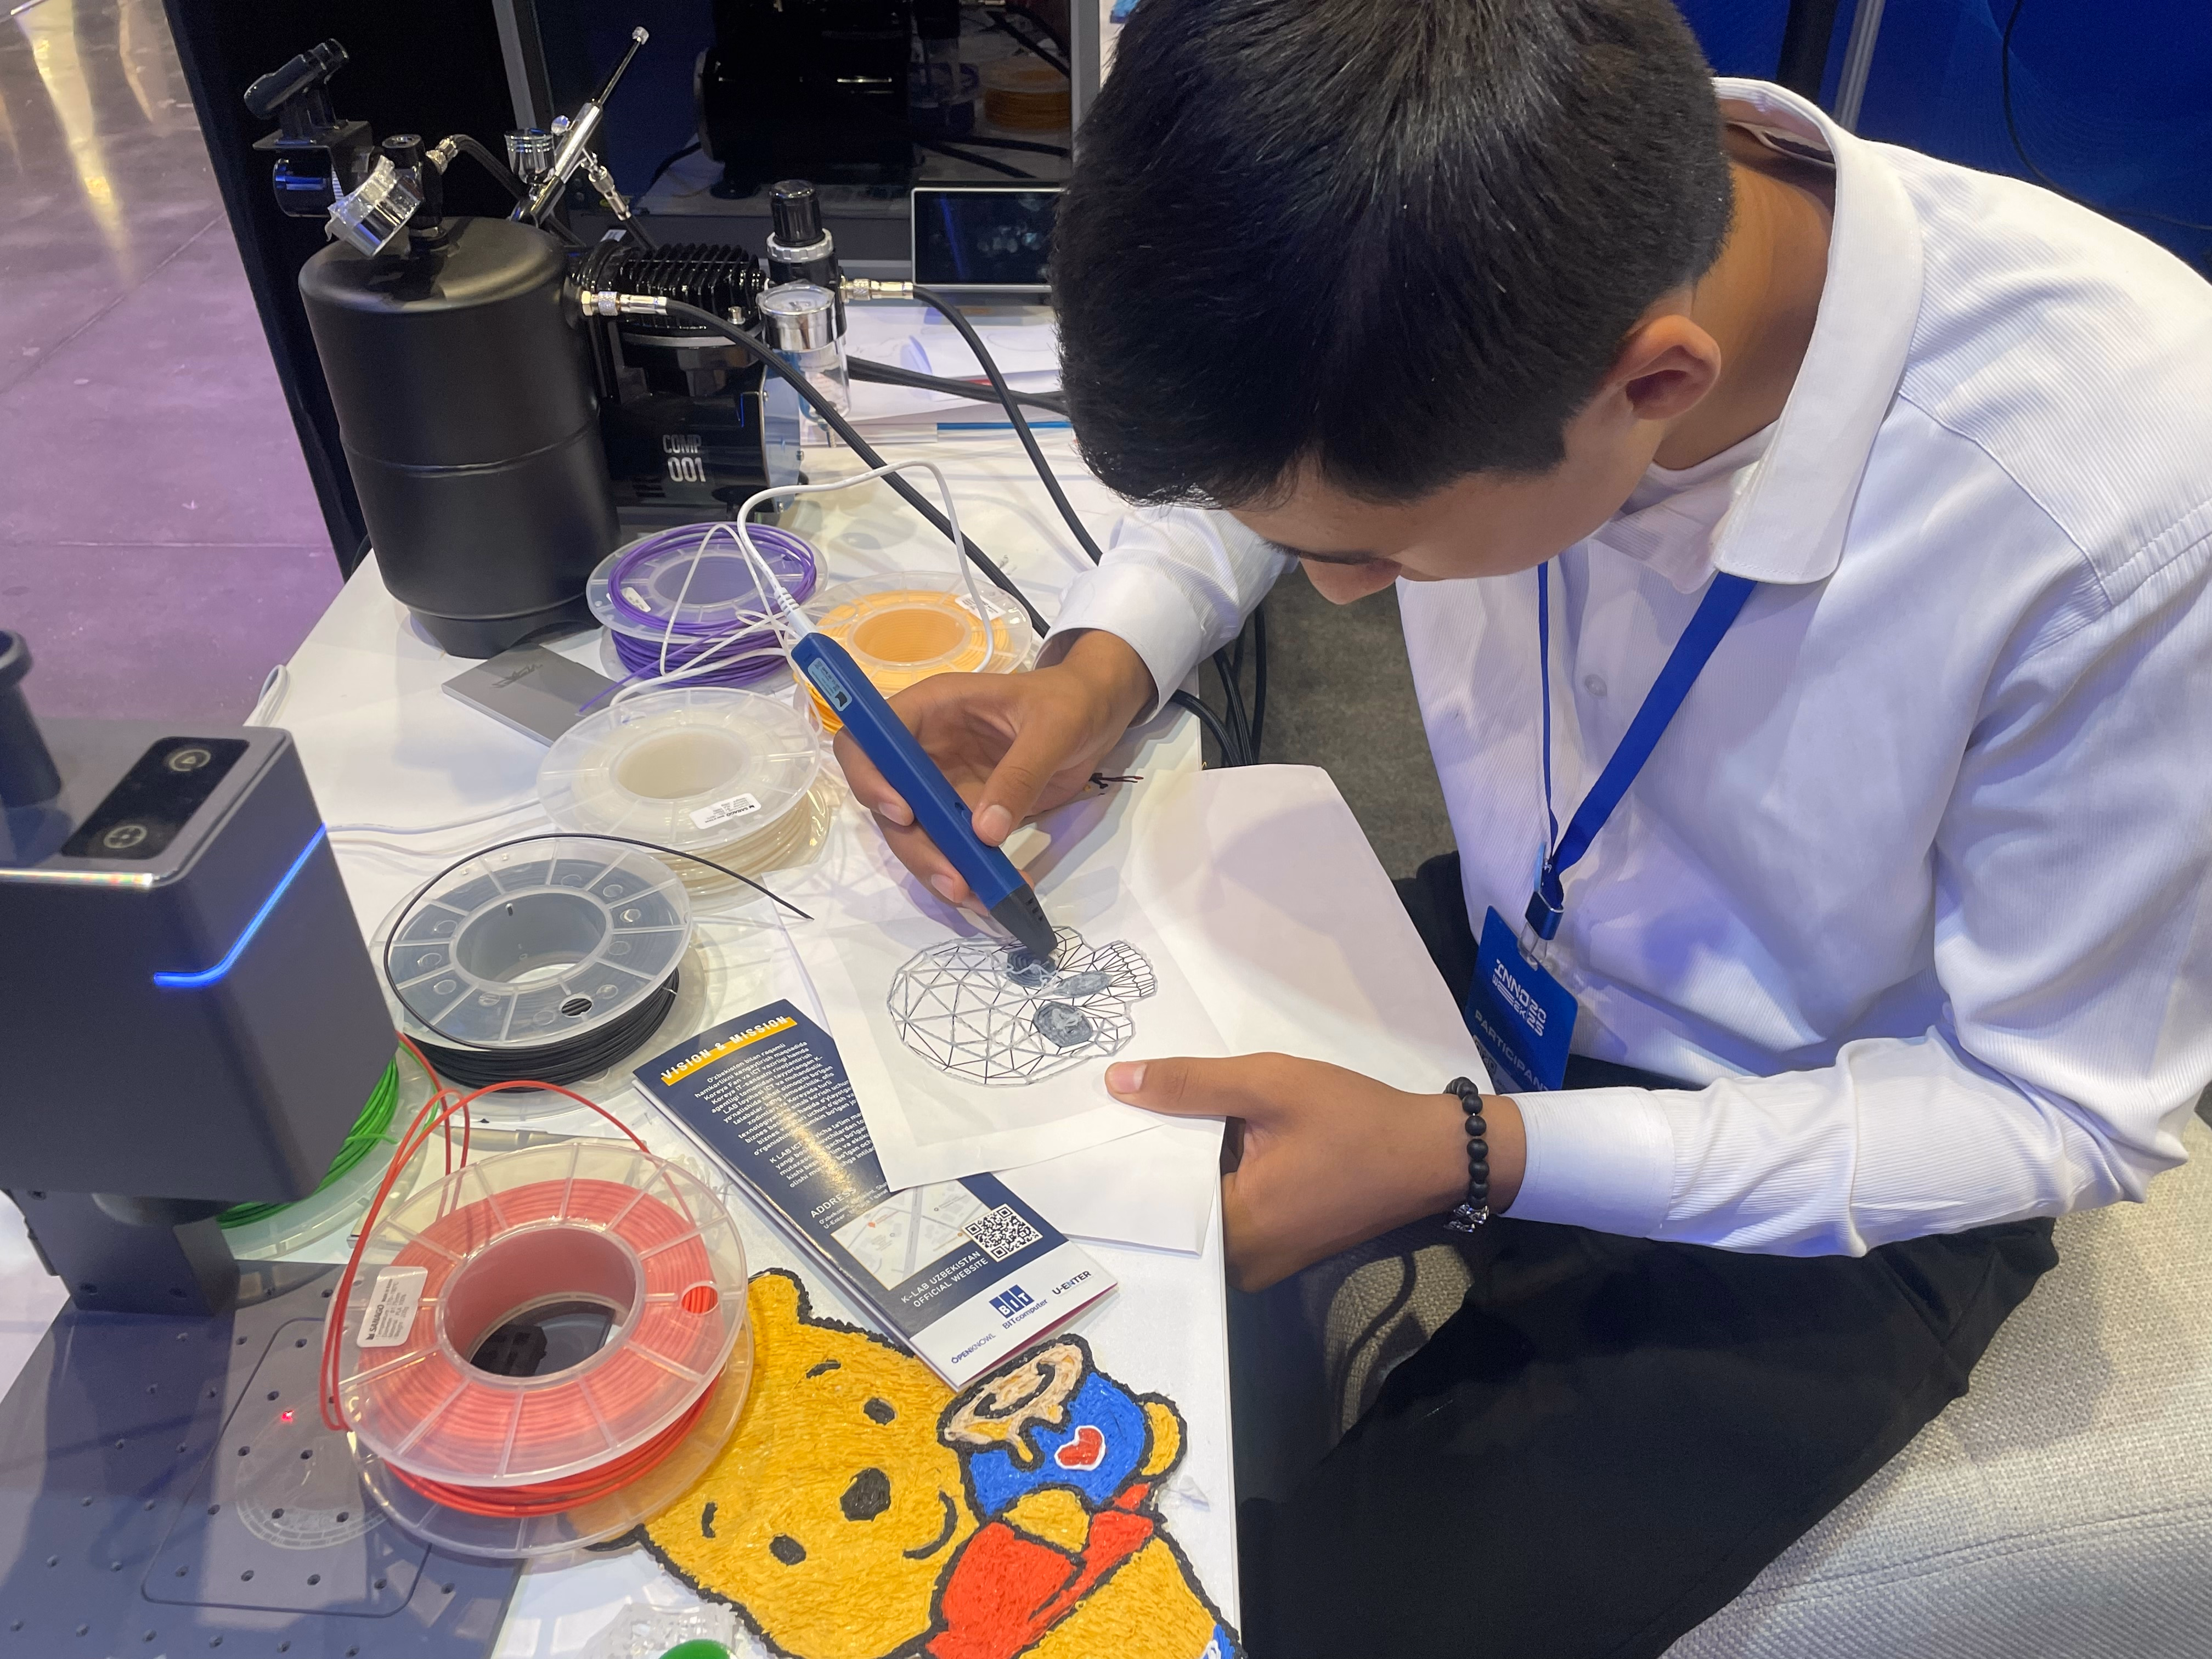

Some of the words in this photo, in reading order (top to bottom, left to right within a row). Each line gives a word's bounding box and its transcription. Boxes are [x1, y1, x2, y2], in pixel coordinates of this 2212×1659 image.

[662, 435, 702, 454] COMP
[668, 457, 706, 482] 001
[661, 1049, 710, 1079] VISION
[715, 1041, 726, 1052] &
[729, 1016, 788, 1043] MISSION
[707, 1061, 744, 1084] O'zbekiston
[744, 1054, 760, 1064] bilan
[761, 1042, 786, 1057] raqamli
[1475, 1009, 1549, 1091] PARTICIPANT
[693, 1071, 734, 1099] hamkorlikni
[734, 1055, 773, 1076] kengaytirish
[774, 1041, 808, 1058] maqsadida
[703, 1085, 729, 1101] Koreya
[729, 1079, 741, 1087] Fan
[750, 1068, 761, 1076] ICT
[761, 1056, 787, 1071] vazirligi
[787, 1047, 809, 1059] hamda
[710, 1094, 740, 1114] agentligi
[774, 1059, 814, 1080] tayyorlangan
[712, 1090, 736, 1105] Koreya
[772, 1052, 812, 1073] rivojlantirish
[723, 1103, 738, 1115] LAB
[738, 1088, 764, 1106] loyihasi
[784, 1062, 822, 1082] muhandislik
[821, 1071, 834, 1080] ofis
[723, 1098, 761, 1124] yo'nalishida
[781, 1074, 809, 1092] olmoqchi
[810, 1065, 833, 1077] bo'lgan
[787, 1087, 818, 1104] Koreyada
[817, 1080, 832, 1089] turli
[791, 1098, 809, 1110] sinab
[808, 1087, 831, 1101] ko'rish
[825, 1102, 849, 1116] bo'lgan
[744, 1128, 768, 1143] biznes
[819, 1085, 853, 1104] o'ylayotga
[756, 1130, 780, 1145] biznes
[807, 1105, 827, 1118] uchun
[827, 1096, 846, 1108] o'qish
[769, 1155, 777, 1164] K
[776, 1147, 792, 1159] LAB
[791, 1141, 803, 1151] ICT
[831, 1116, 850, 1129] ta'lim
[775, 1155, 794, 1170] yangi
[786, 1167, 804, 1180] kishi
[789, 1173, 809, 1188] olishi
[836, 1146, 860, 1160] bo'lgan
[810, 1186, 857, 1218] ADDRESS
[901, 1282, 929, 1304] K-LAB
[929, 1250, 980, 1285] UZBEKISTAN
[913, 1279, 952, 1308] OFFICIAL
[951, 1257, 988, 1283] WEBSITE
[1052, 1269, 1091, 1295] U-ENTER
[370, 1305, 384, 1332] SANAGO
[998, 1291, 1029, 1317] BIT
[1002, 1298, 1048, 1329] BITcomputer
[951, 1331, 996, 1364] OPENKNOWL
